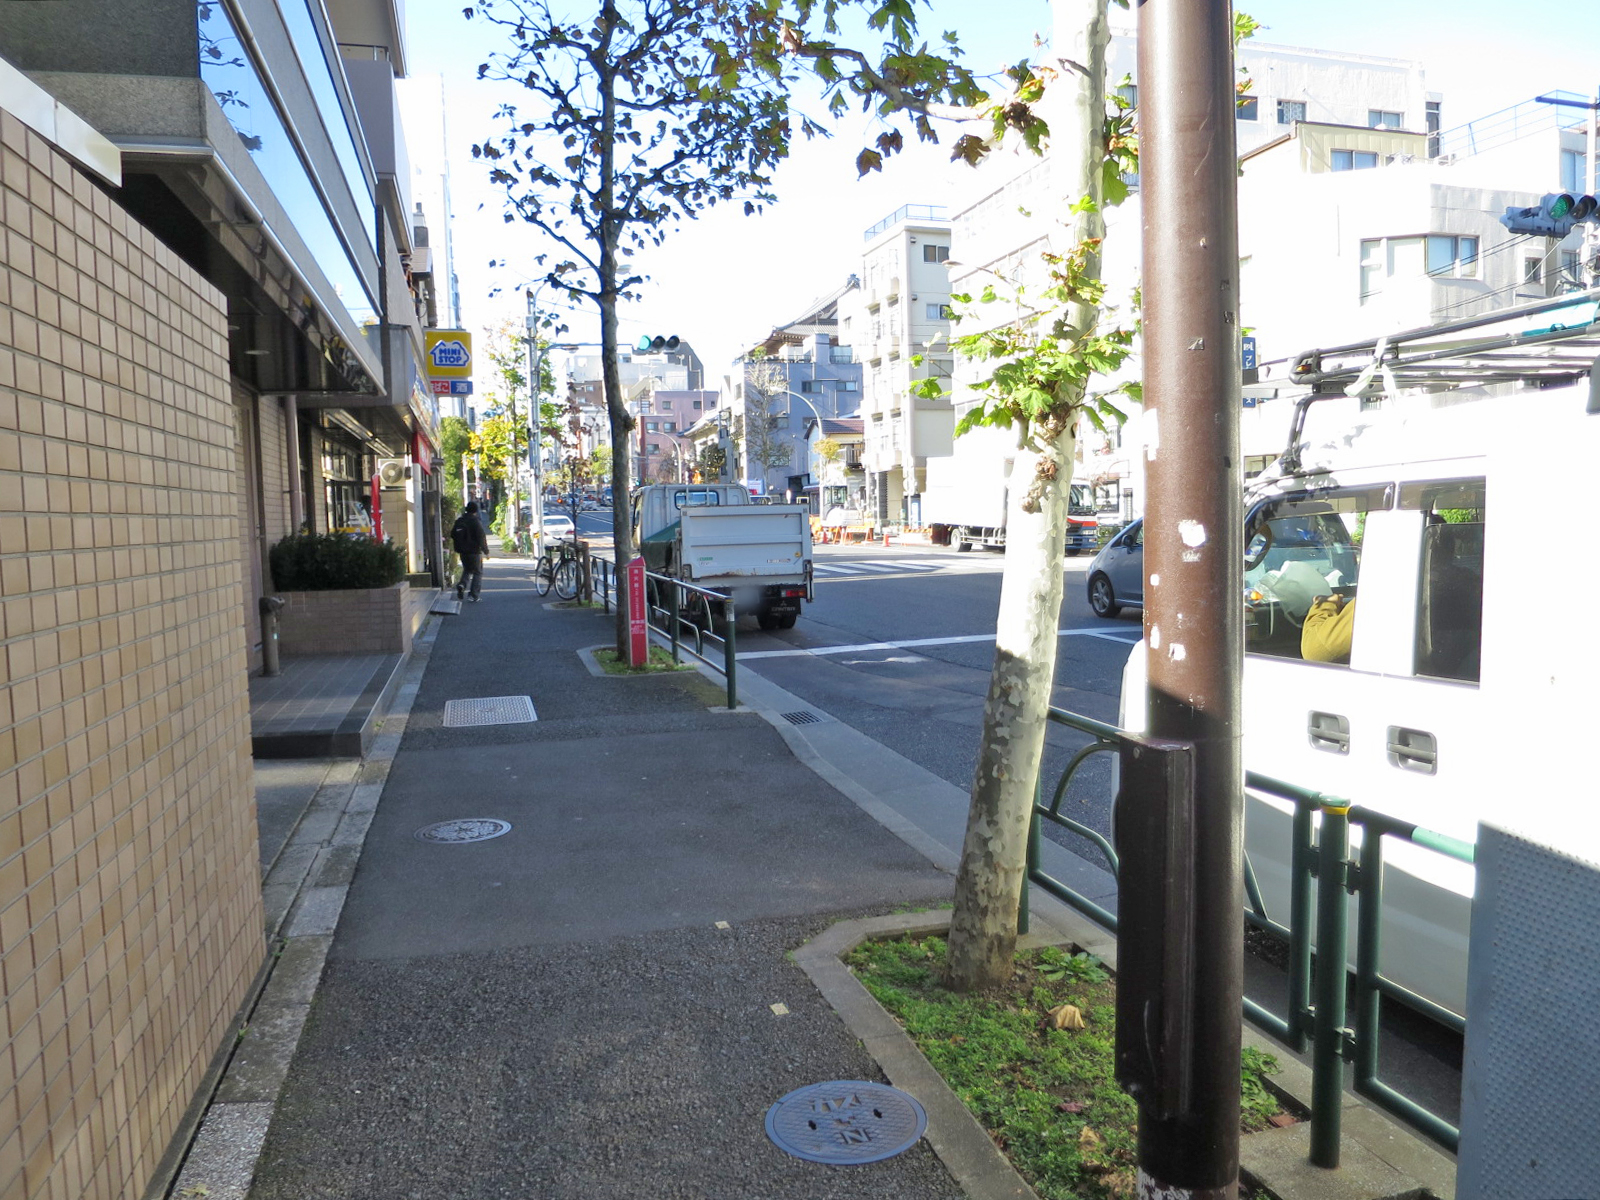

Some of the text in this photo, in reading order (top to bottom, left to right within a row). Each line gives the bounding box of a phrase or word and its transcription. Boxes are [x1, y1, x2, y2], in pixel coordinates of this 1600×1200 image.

[438, 347, 461, 355] MINI
[438, 355, 462, 363] STOP
[455, 382, 468, 392] 酒
